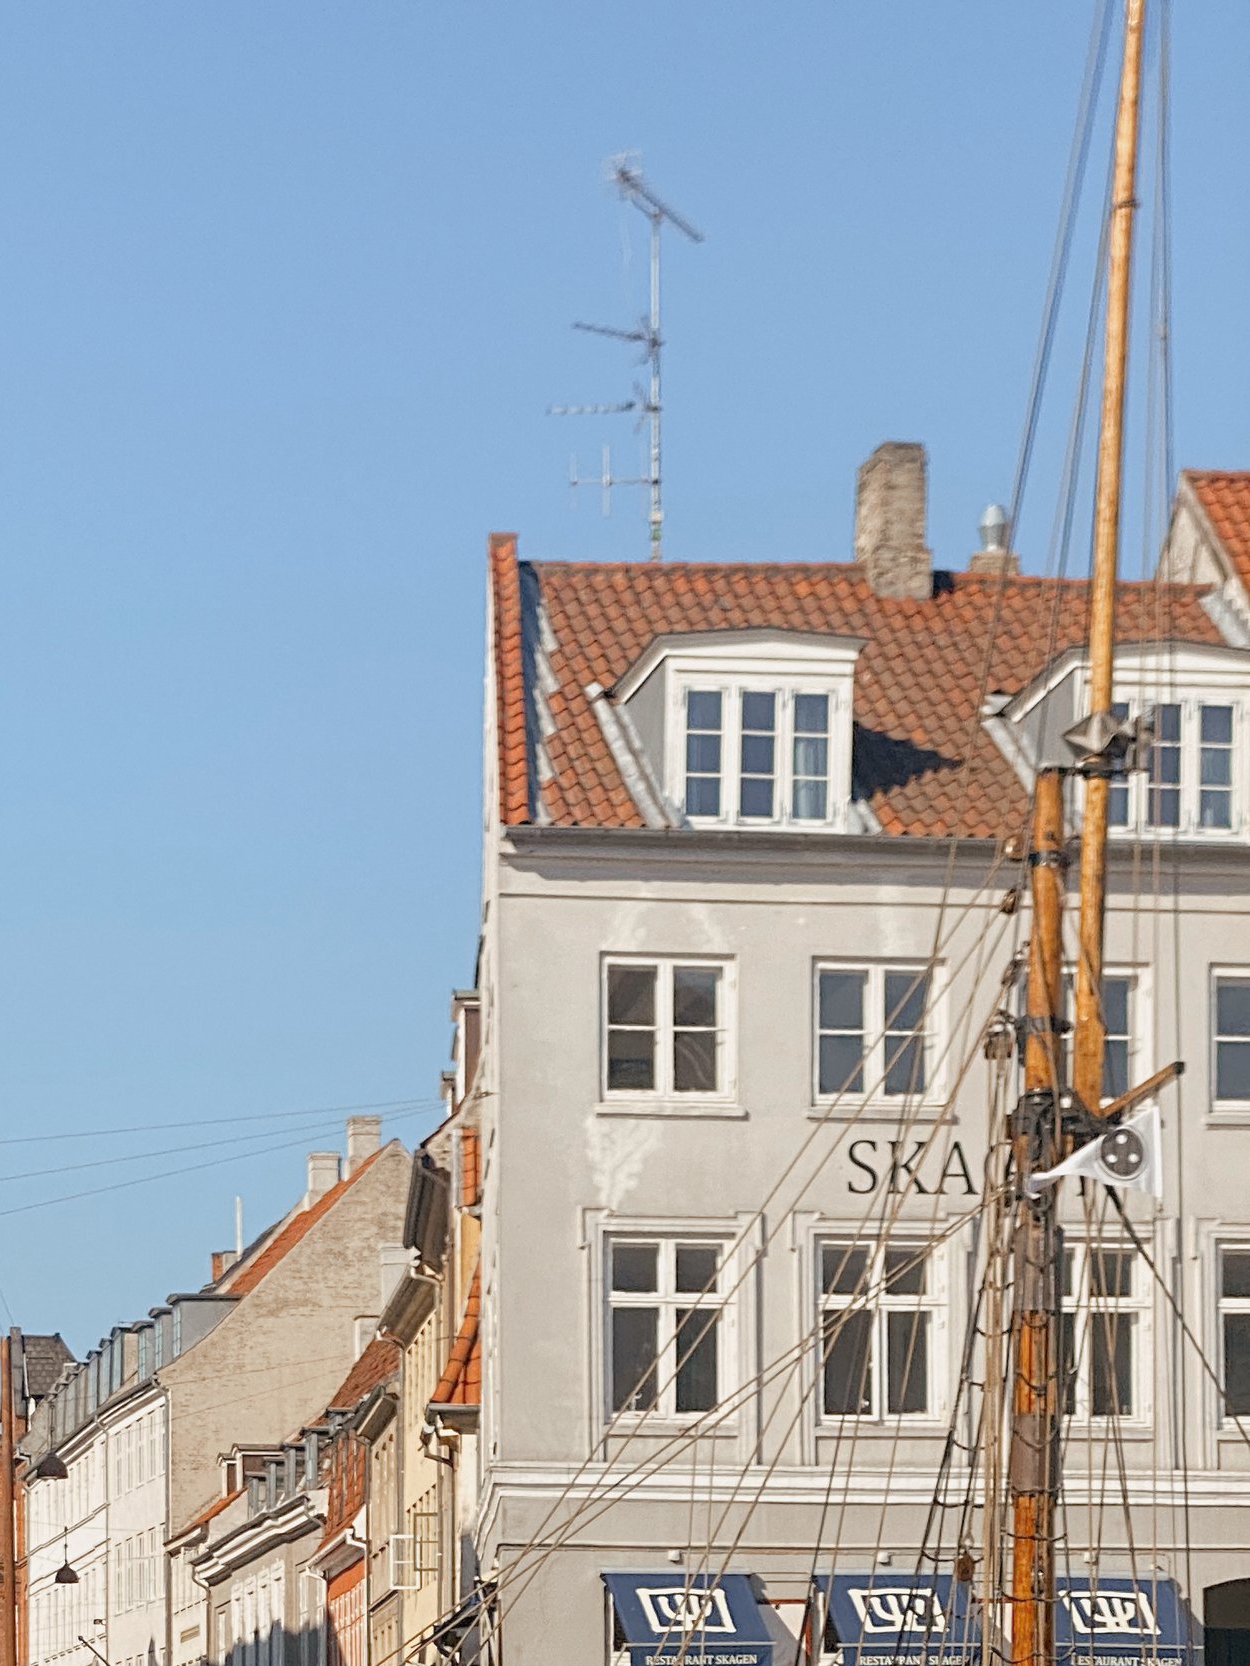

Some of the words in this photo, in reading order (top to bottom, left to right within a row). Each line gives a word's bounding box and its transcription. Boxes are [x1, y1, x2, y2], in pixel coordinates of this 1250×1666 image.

[645, 1655, 713, 1665] RESTARANT
[715, 1654, 757, 1665] SKAGEN
[859, 1655, 922, 1666] RESTARAN
